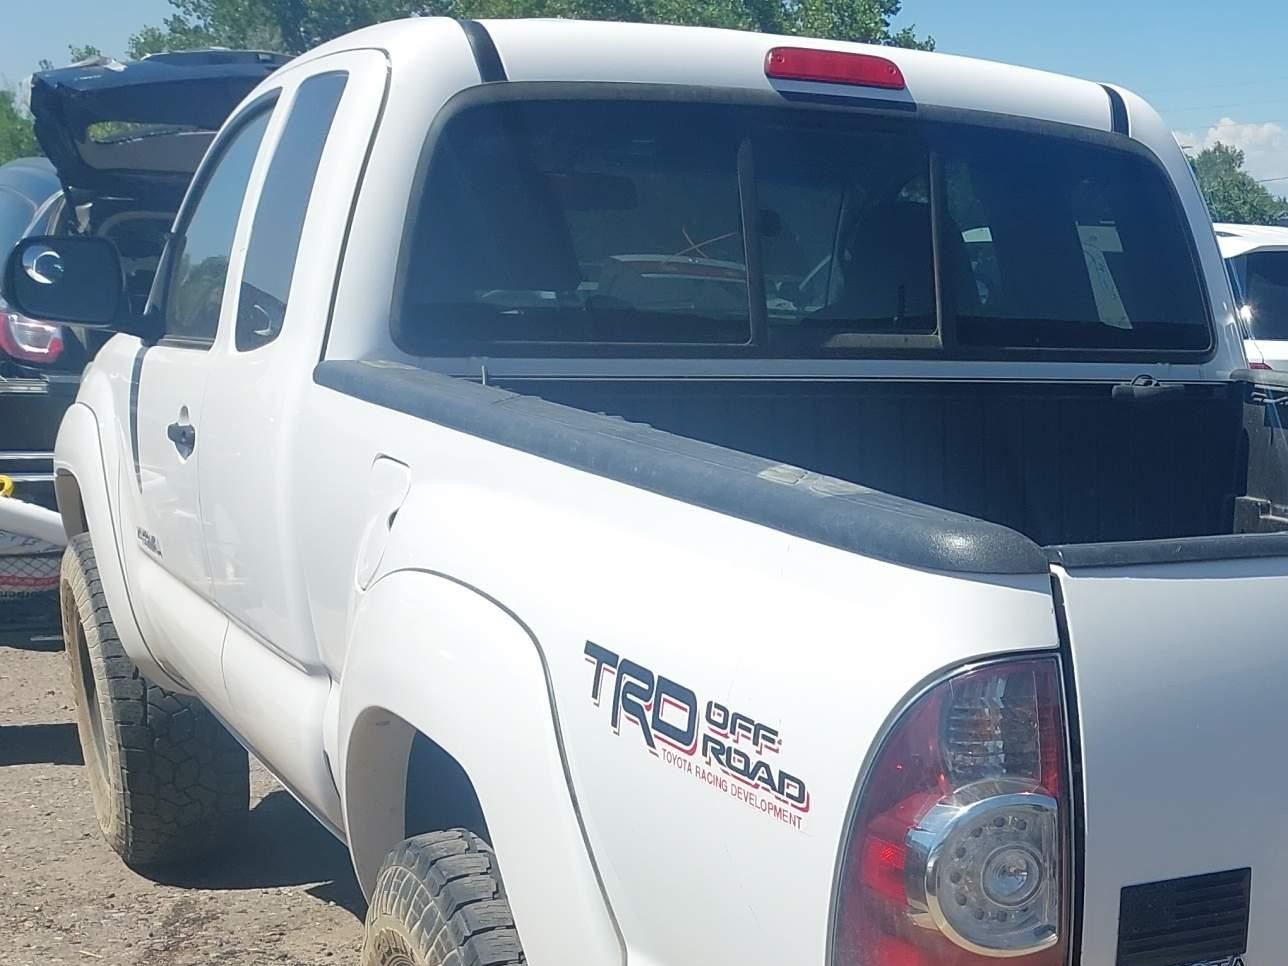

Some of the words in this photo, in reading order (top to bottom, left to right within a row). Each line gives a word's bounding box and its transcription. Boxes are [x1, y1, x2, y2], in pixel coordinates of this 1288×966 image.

[584, 639, 699, 757] TRD
[705, 700, 781, 755] OFF
[662, 748, 693, 774] TOYOTA
[695, 766, 728, 793] RACING
[730, 783, 803, 830] DEVELOPMENT
[701, 733, 810, 813] ROAD
